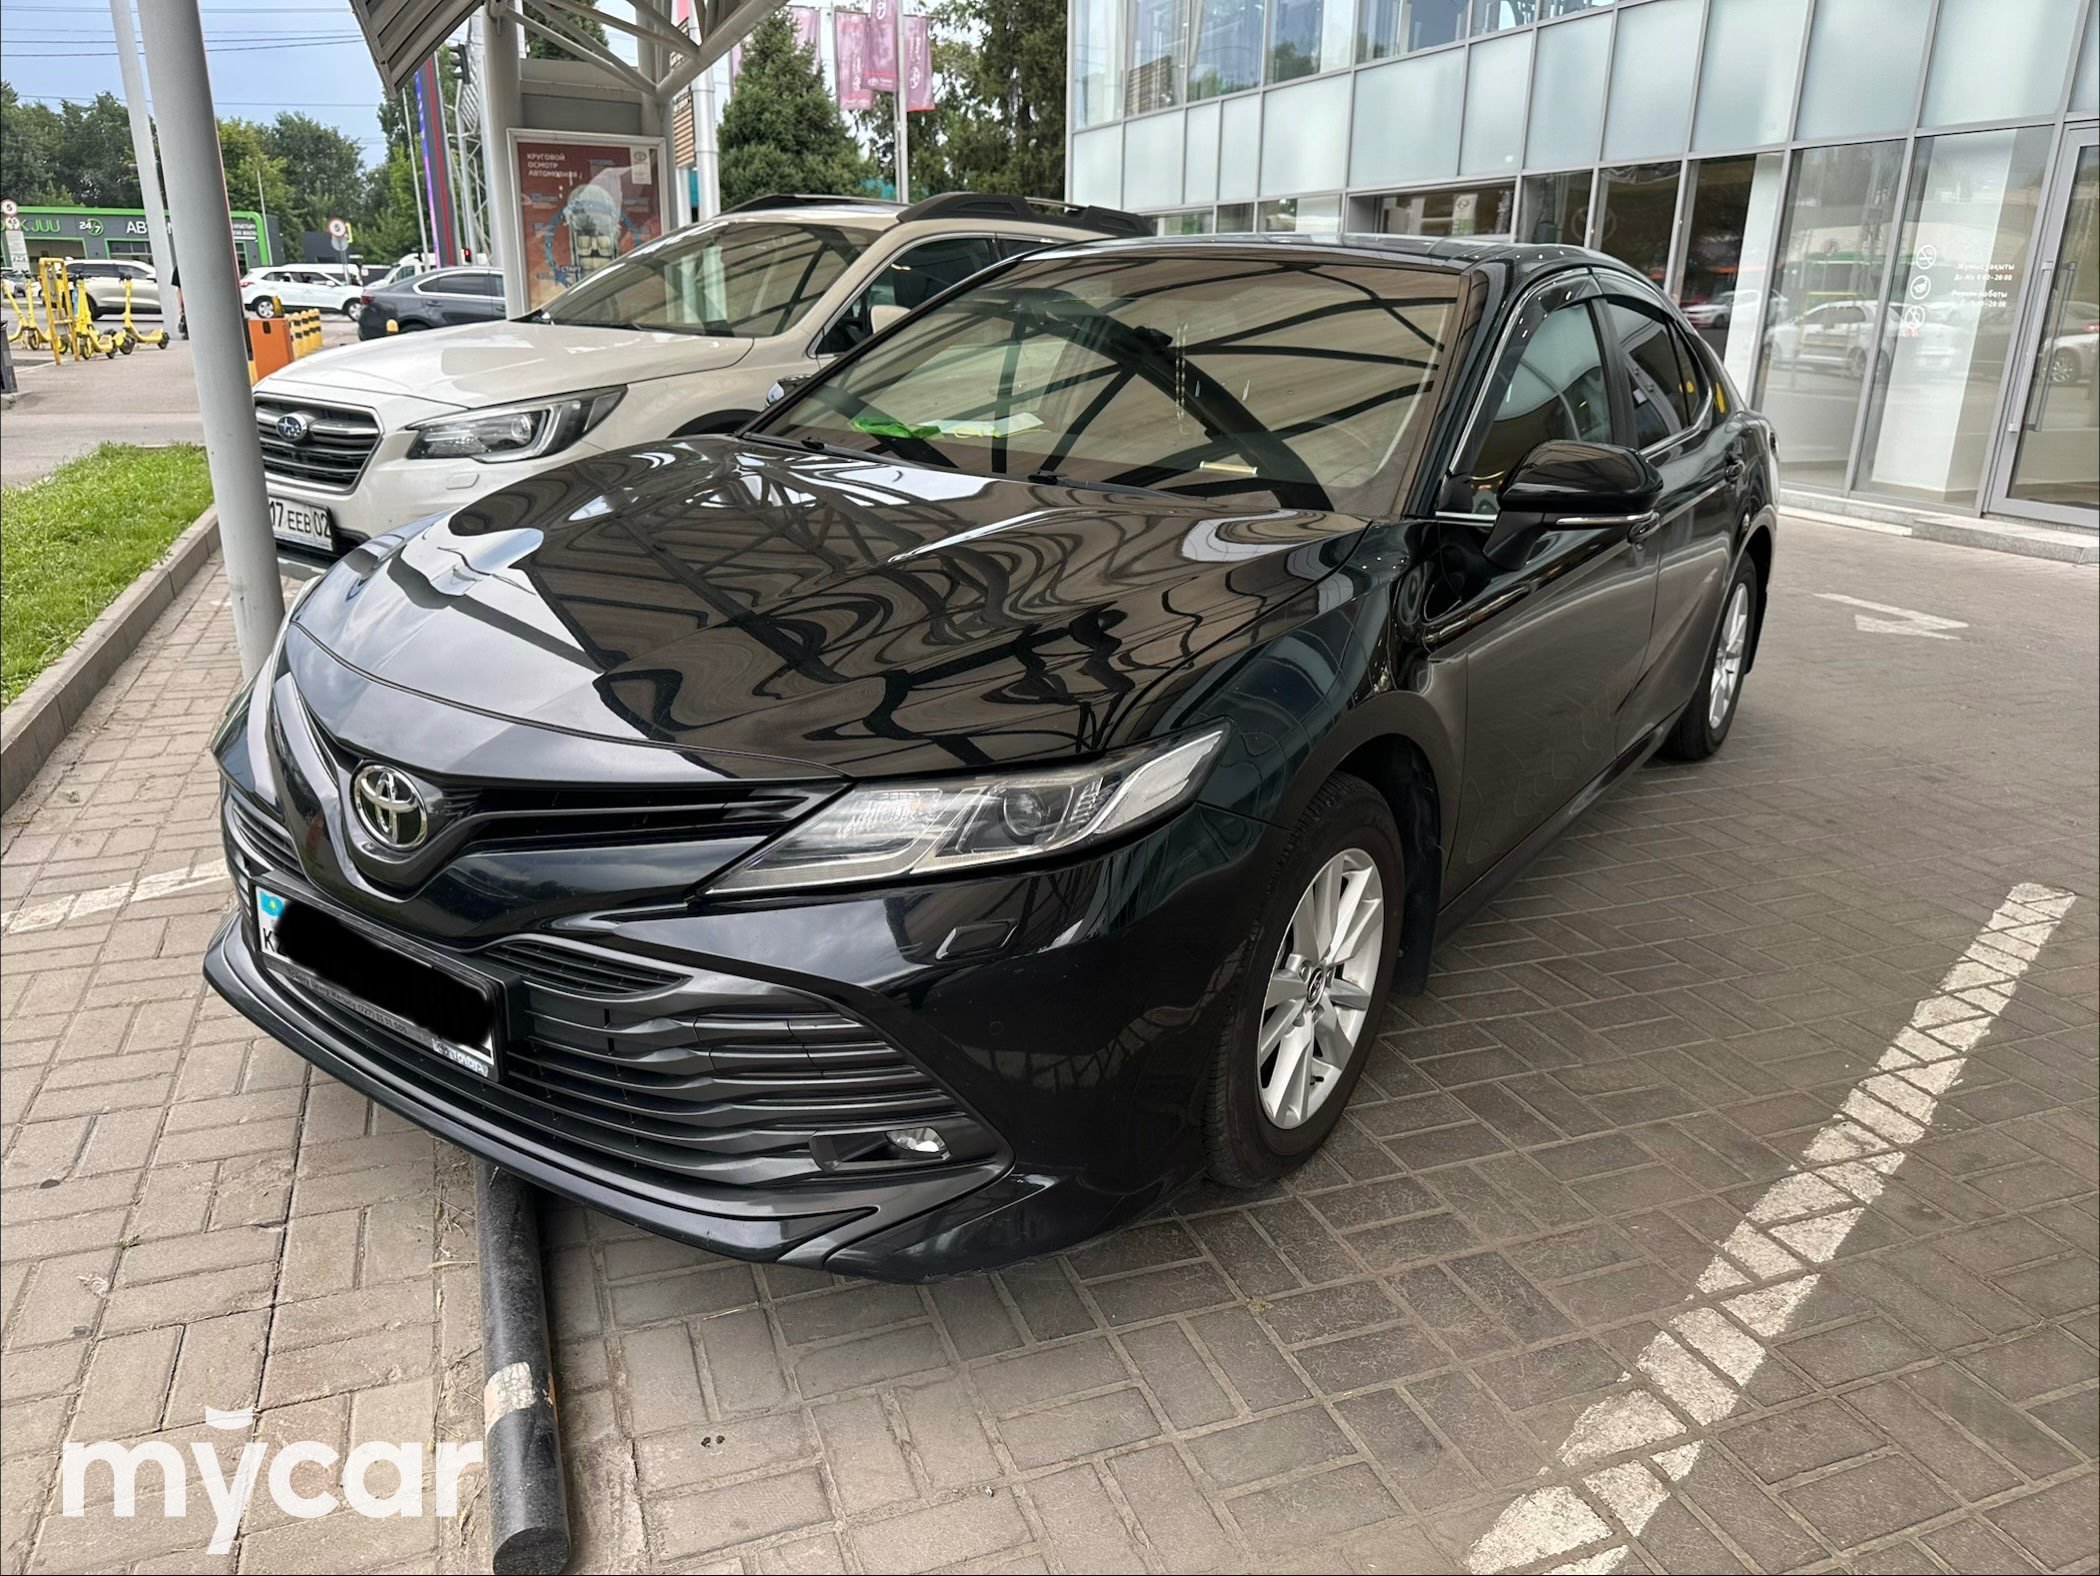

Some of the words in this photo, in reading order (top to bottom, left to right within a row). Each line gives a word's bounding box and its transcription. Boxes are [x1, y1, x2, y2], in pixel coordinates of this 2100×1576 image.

[527, 152, 566, 161] КРУГОВОЙ
[527, 161, 559, 169] ОСМОТР
[31, 219, 61, 232] JUU
